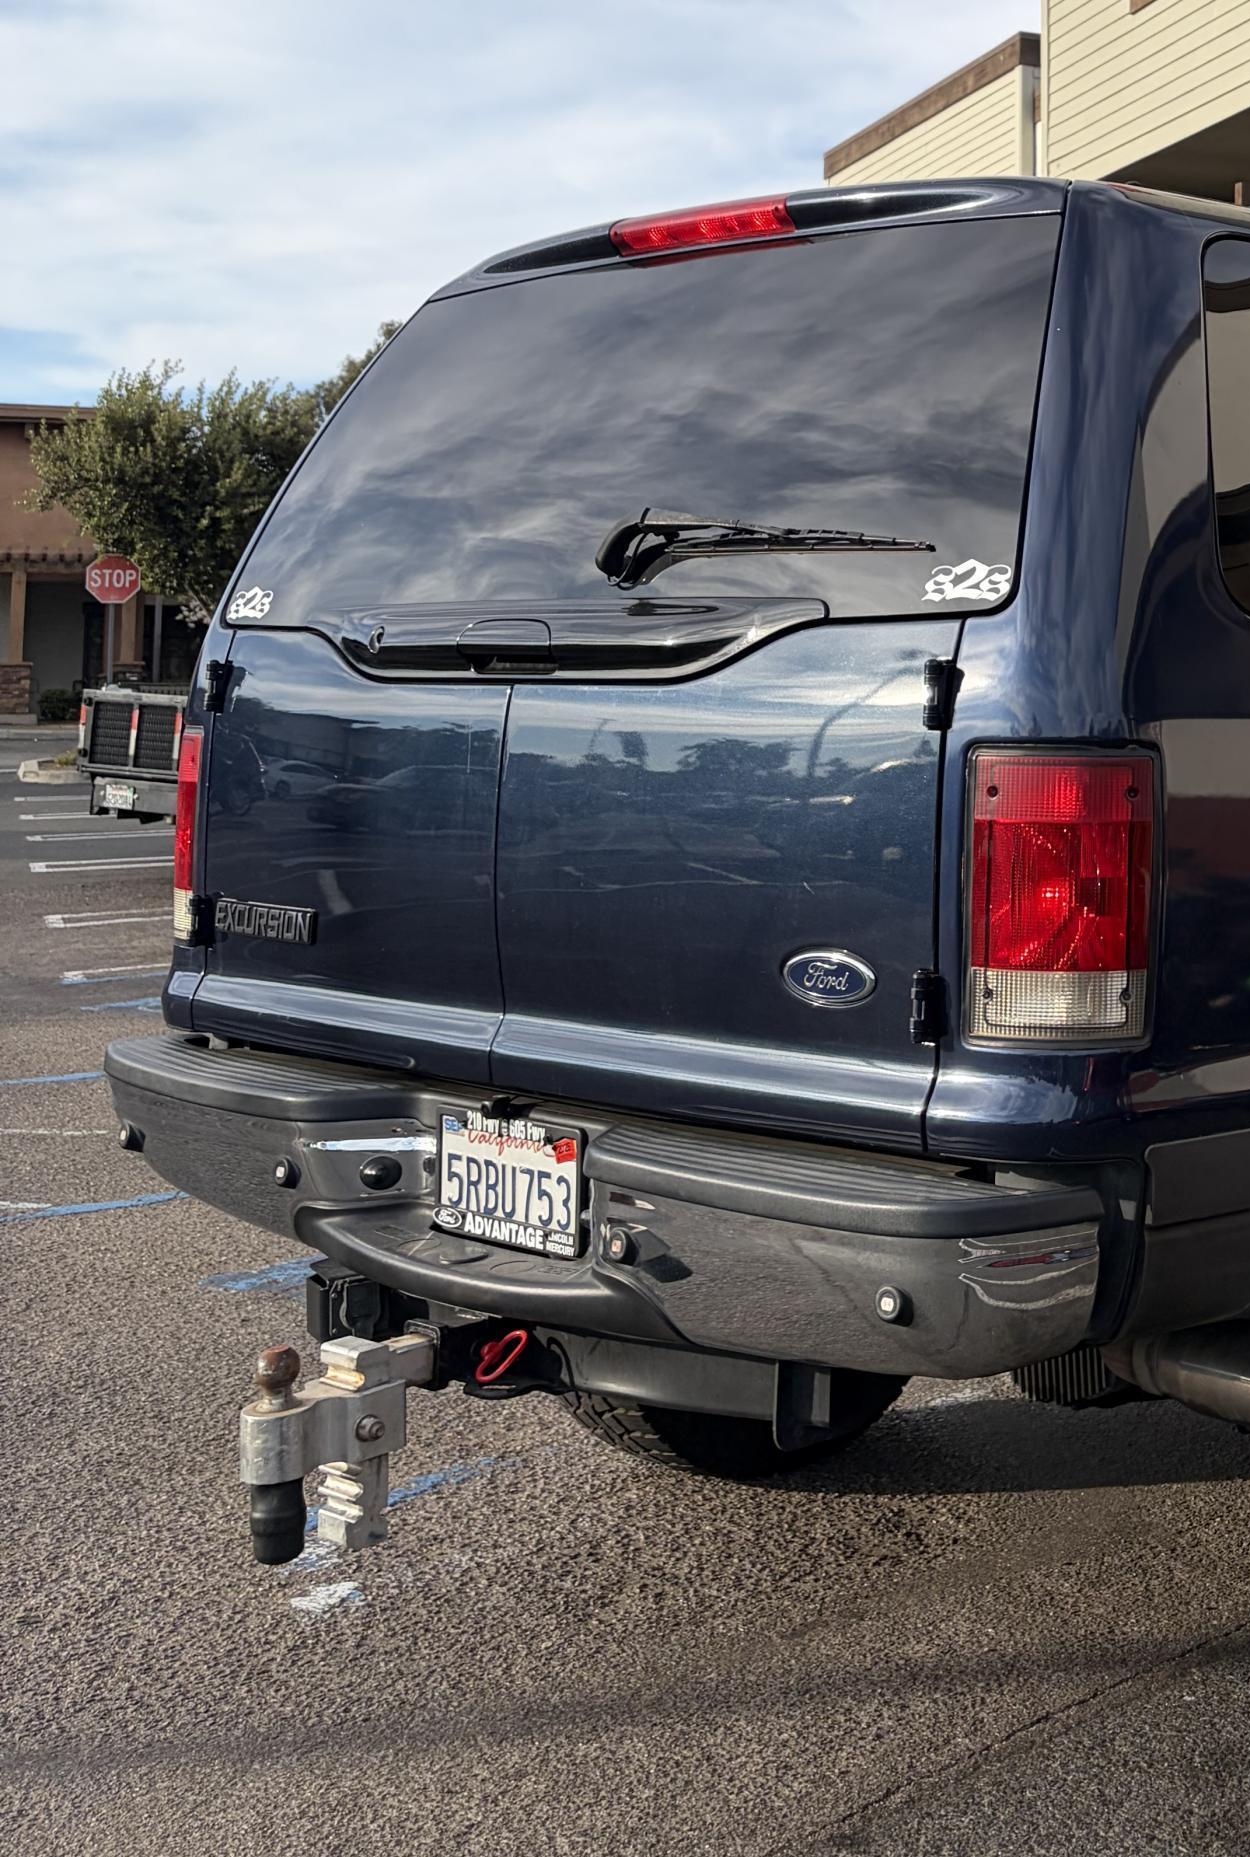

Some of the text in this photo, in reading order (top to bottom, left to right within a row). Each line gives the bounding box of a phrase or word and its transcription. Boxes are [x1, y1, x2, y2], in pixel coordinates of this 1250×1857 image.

[90, 569, 137, 588] STOP
[214, 901, 312, 943] EXCURSION
[803, 961, 849, 991] Ford
[467, 1110, 482, 1131] 210
[509, 1119, 526, 1140] 605
[447, 1152, 571, 1231] 5RBU753
[464, 1211, 545, 1250] ADVANTAGE
